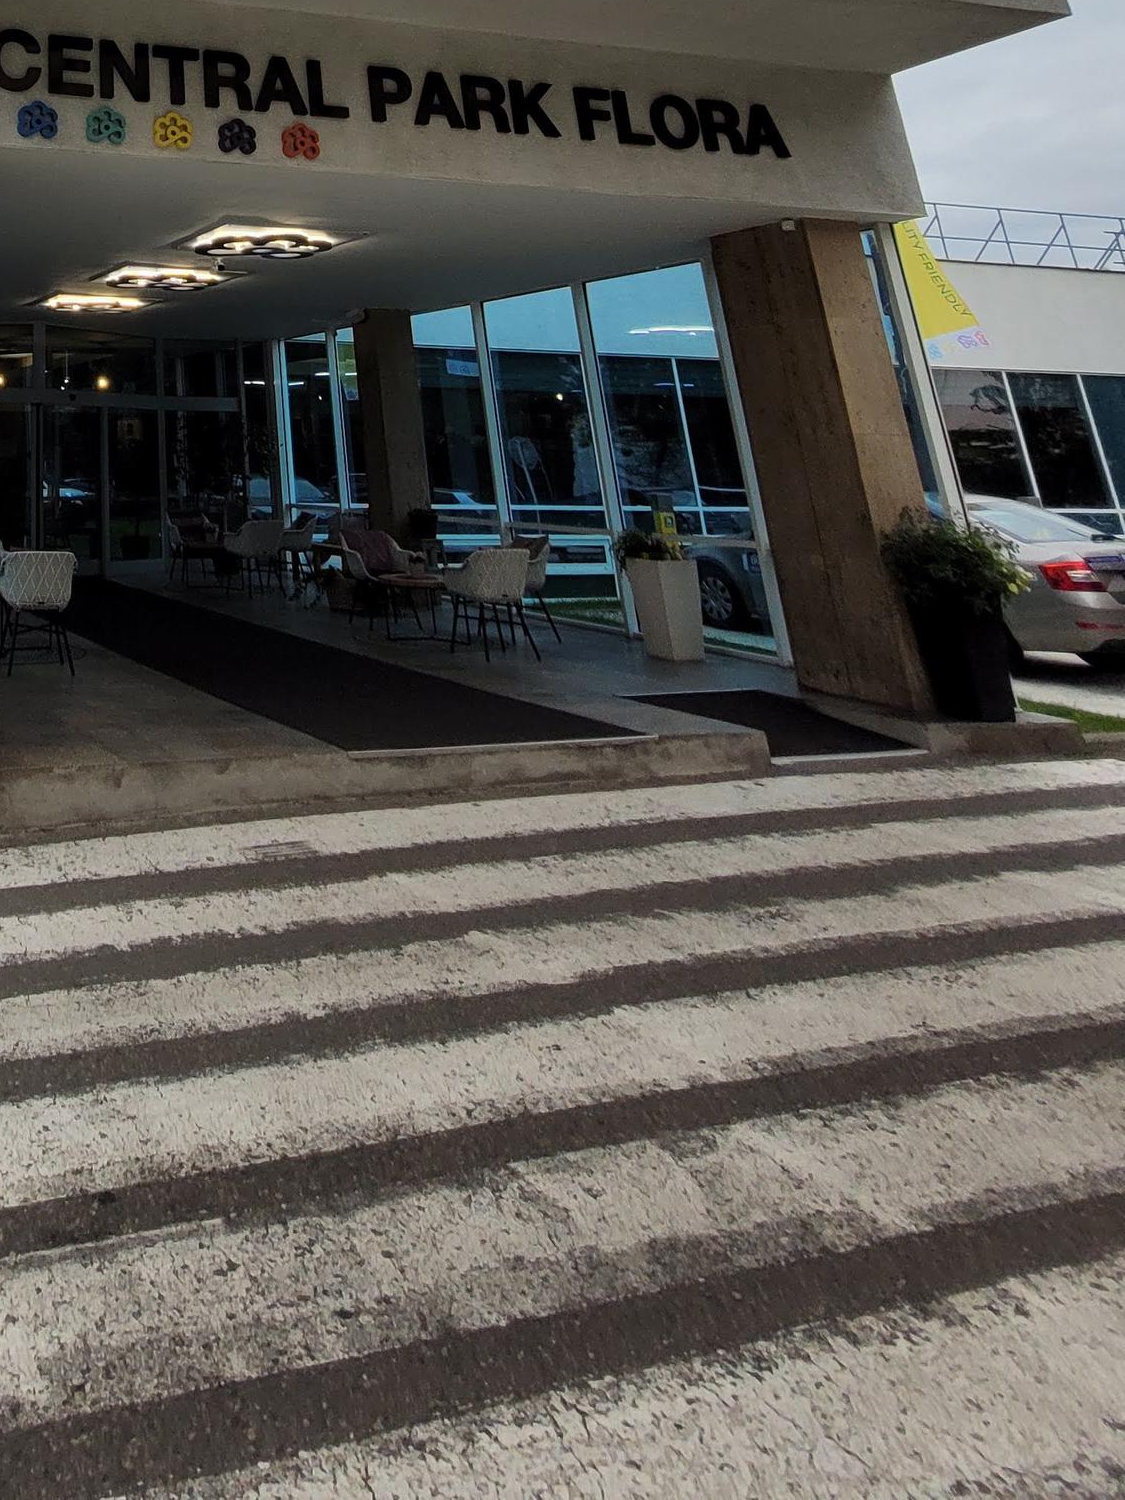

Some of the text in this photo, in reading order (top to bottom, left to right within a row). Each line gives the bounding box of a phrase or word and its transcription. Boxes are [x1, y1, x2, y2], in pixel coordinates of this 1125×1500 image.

[366, 65, 563, 138] PARK
[572, 86, 793, 159] FLORA
[917, 252, 973, 317] FRIENDLY
